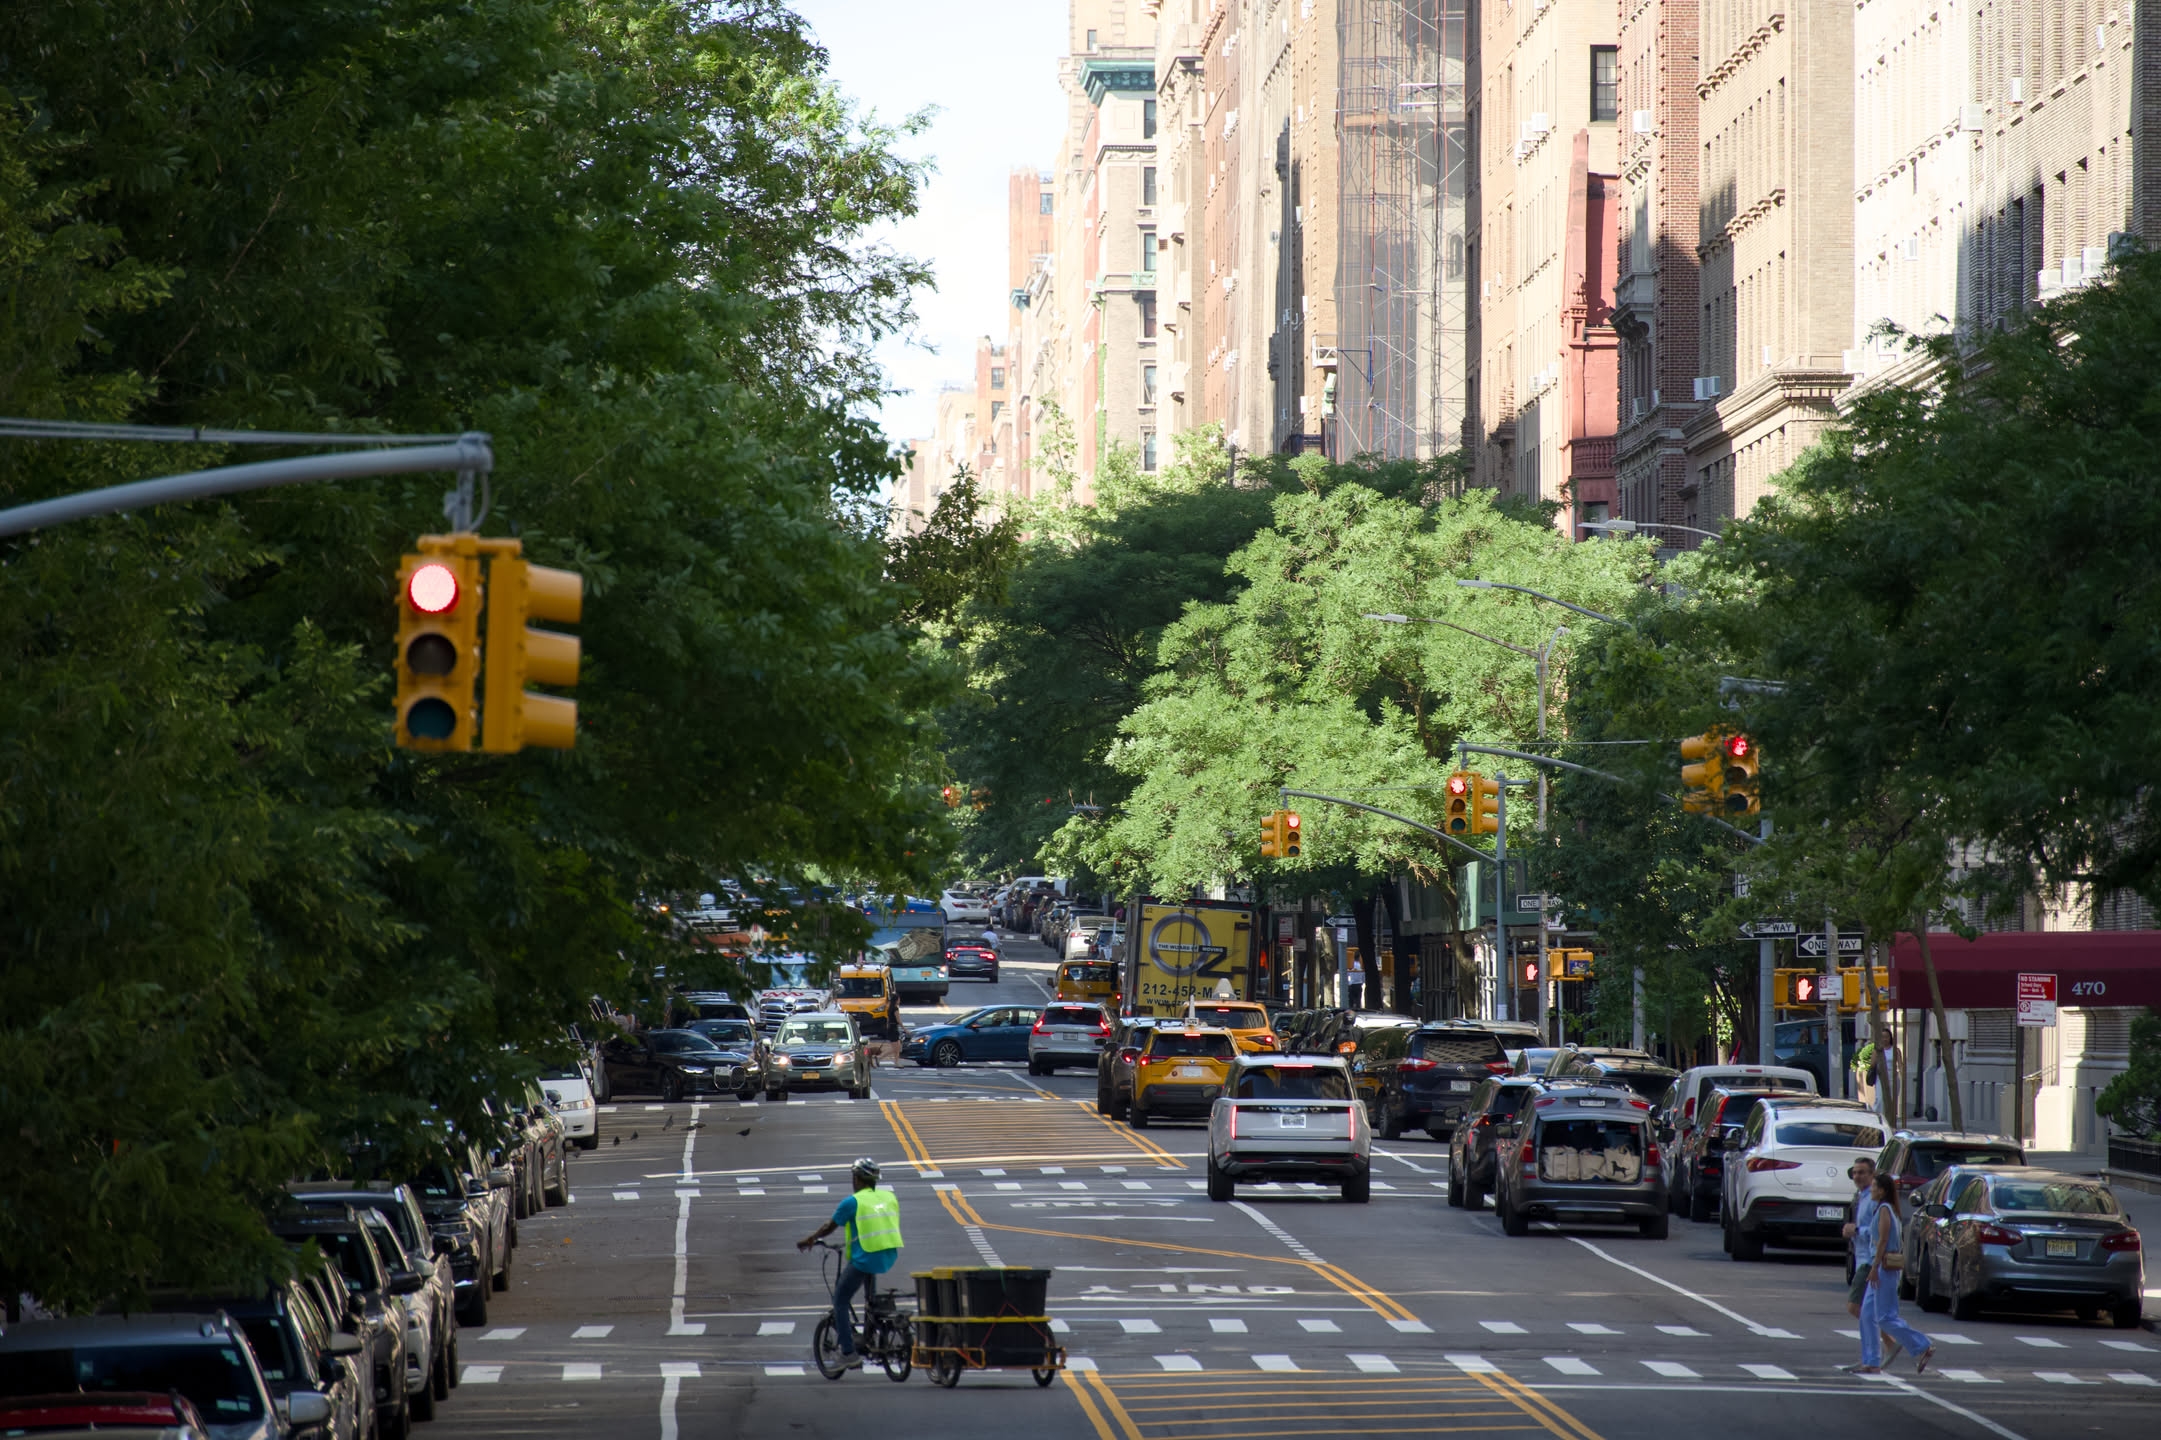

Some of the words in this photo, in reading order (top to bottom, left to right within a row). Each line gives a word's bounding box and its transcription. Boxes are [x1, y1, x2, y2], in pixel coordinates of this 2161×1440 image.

[1773, 923, 1792, 931] WAY
[1807, 941, 1827, 950] ONE
[1143, 983, 1241, 1000] 212-452-ME
[2072, 982, 2106, 995] 470
